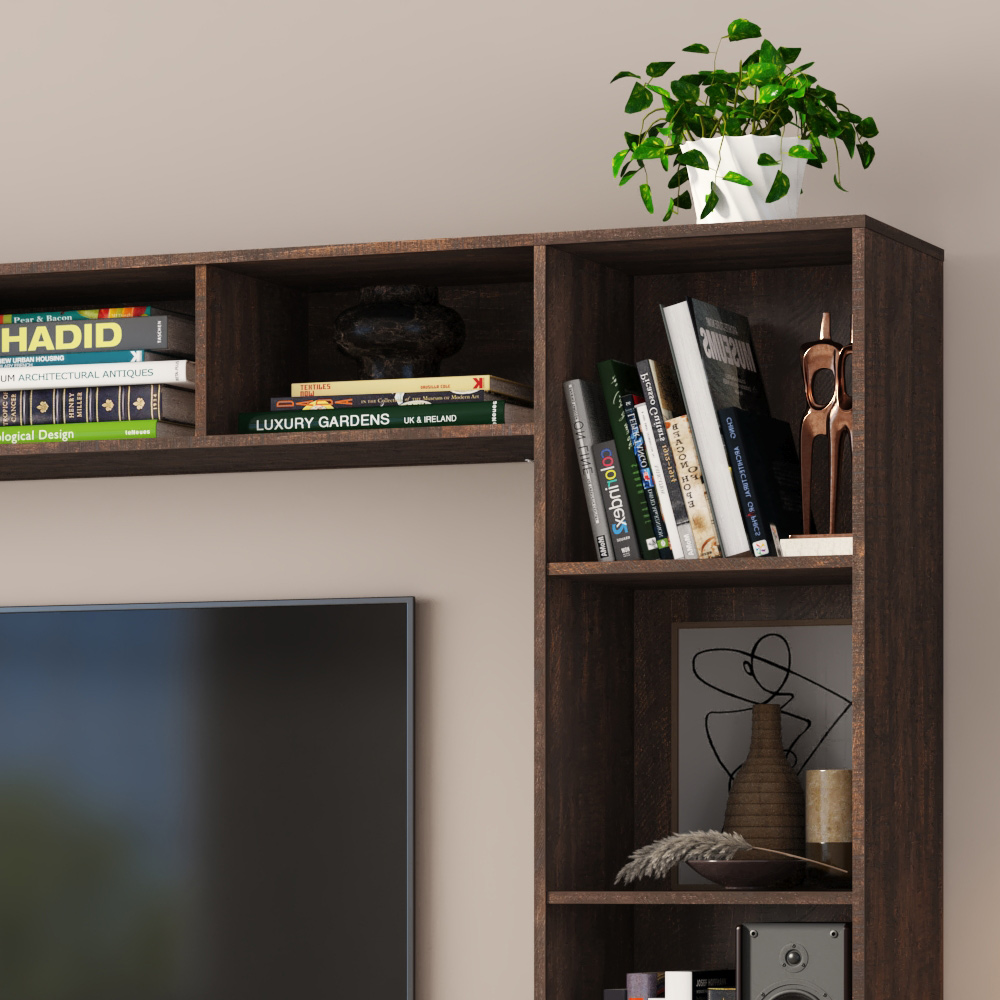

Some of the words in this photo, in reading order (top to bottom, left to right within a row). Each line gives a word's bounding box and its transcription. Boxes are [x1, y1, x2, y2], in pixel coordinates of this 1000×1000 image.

[13, 315, 34, 324] Pear
[46, 314, 72, 322] Bacon
[1, 322, 122, 353] HADID
[18, 371, 100, 382] ARCHITECTURAL
[102, 368, 154, 380] ANTIQUES
[275, 397, 353, 408] DADA
[255, 416, 314, 431] LUXURY
[318, 413, 390, 428] GARDENS
[403, 416, 415, 424] UK
[423, 414, 457, 423] IRELAND
[38, 429, 75, 442] Design
